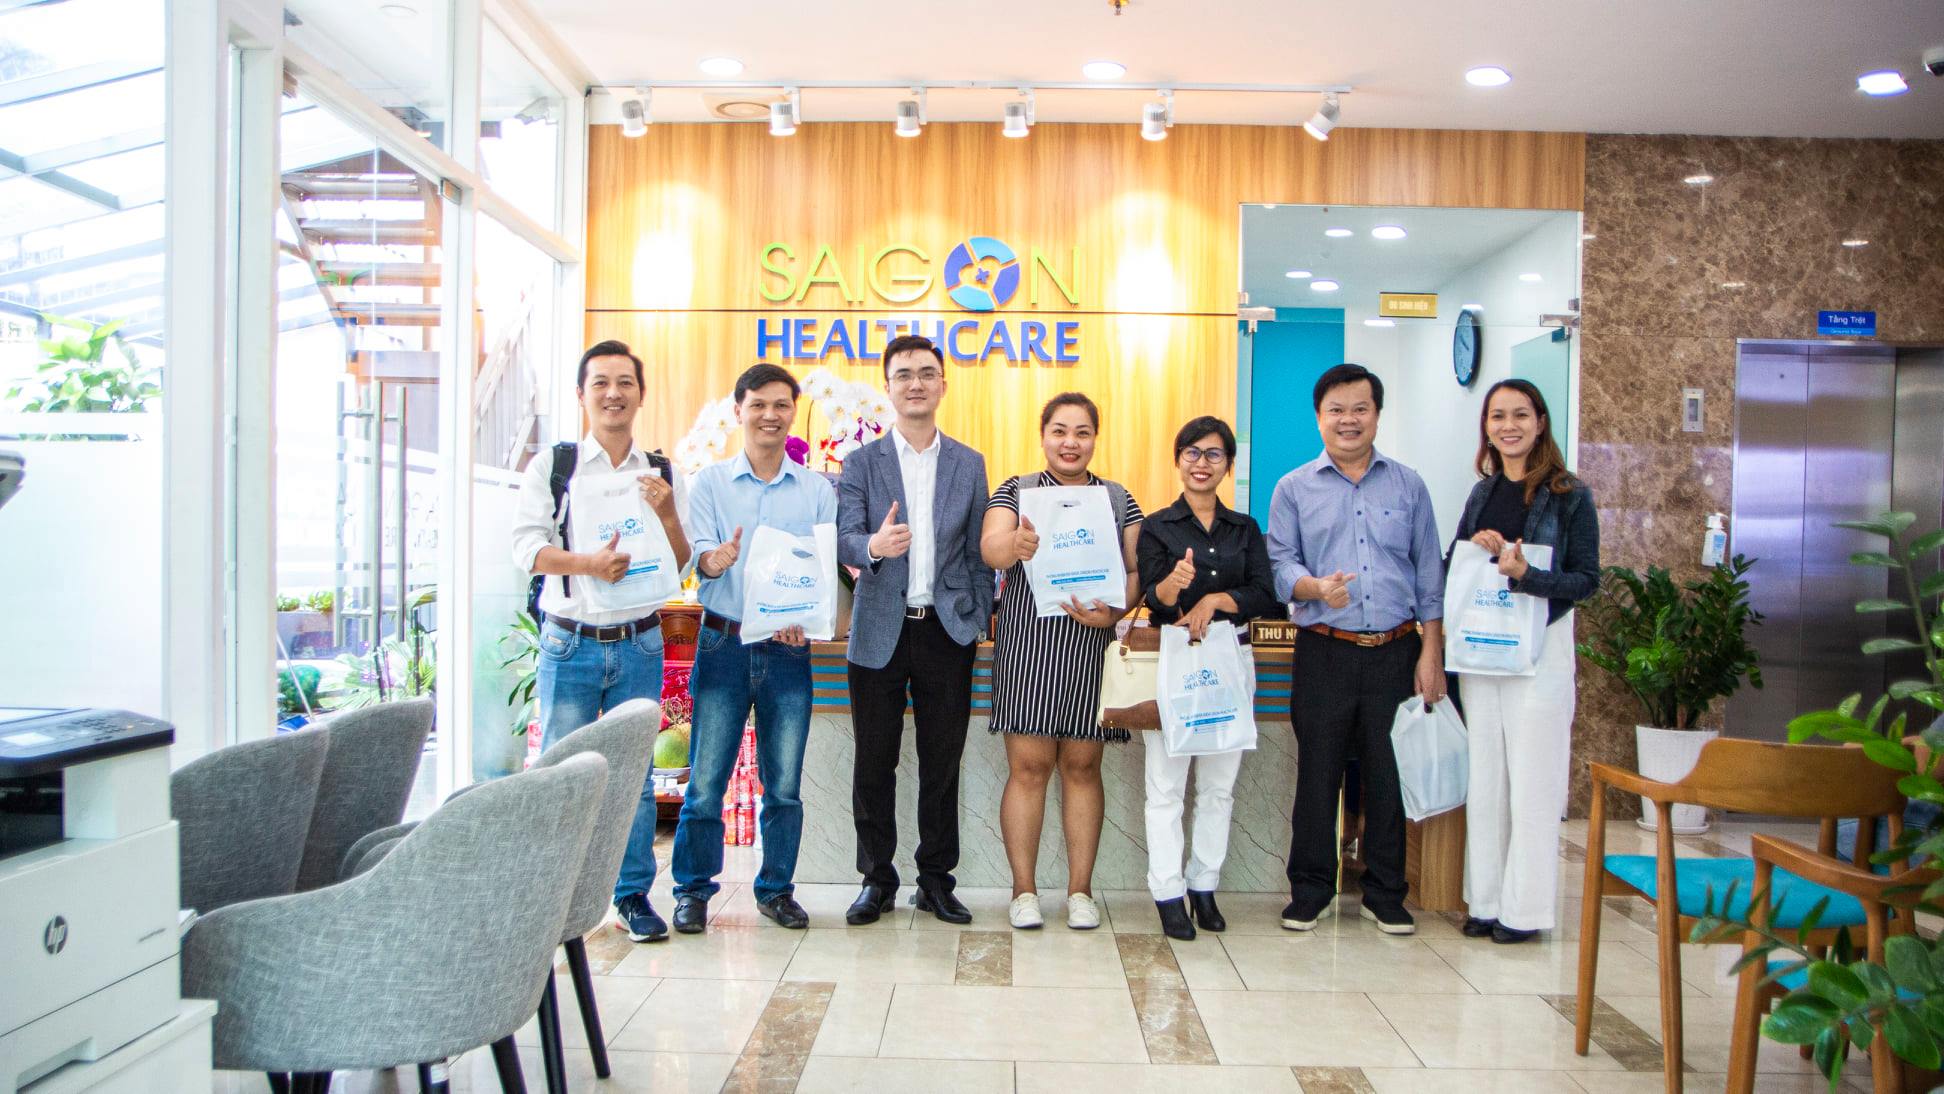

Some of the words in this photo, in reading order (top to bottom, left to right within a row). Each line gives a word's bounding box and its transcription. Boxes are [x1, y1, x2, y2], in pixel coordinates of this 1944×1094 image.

[759, 236, 1080, 312] SAIGON
[757, 319, 1080, 363] HEALTHCARE
[1052, 528, 1094, 541] SAIGON
[1053, 538, 1095, 550] HEALTHCARE
[1258, 627, 1281, 640] THU
[1286, 628, 1297, 640] N
